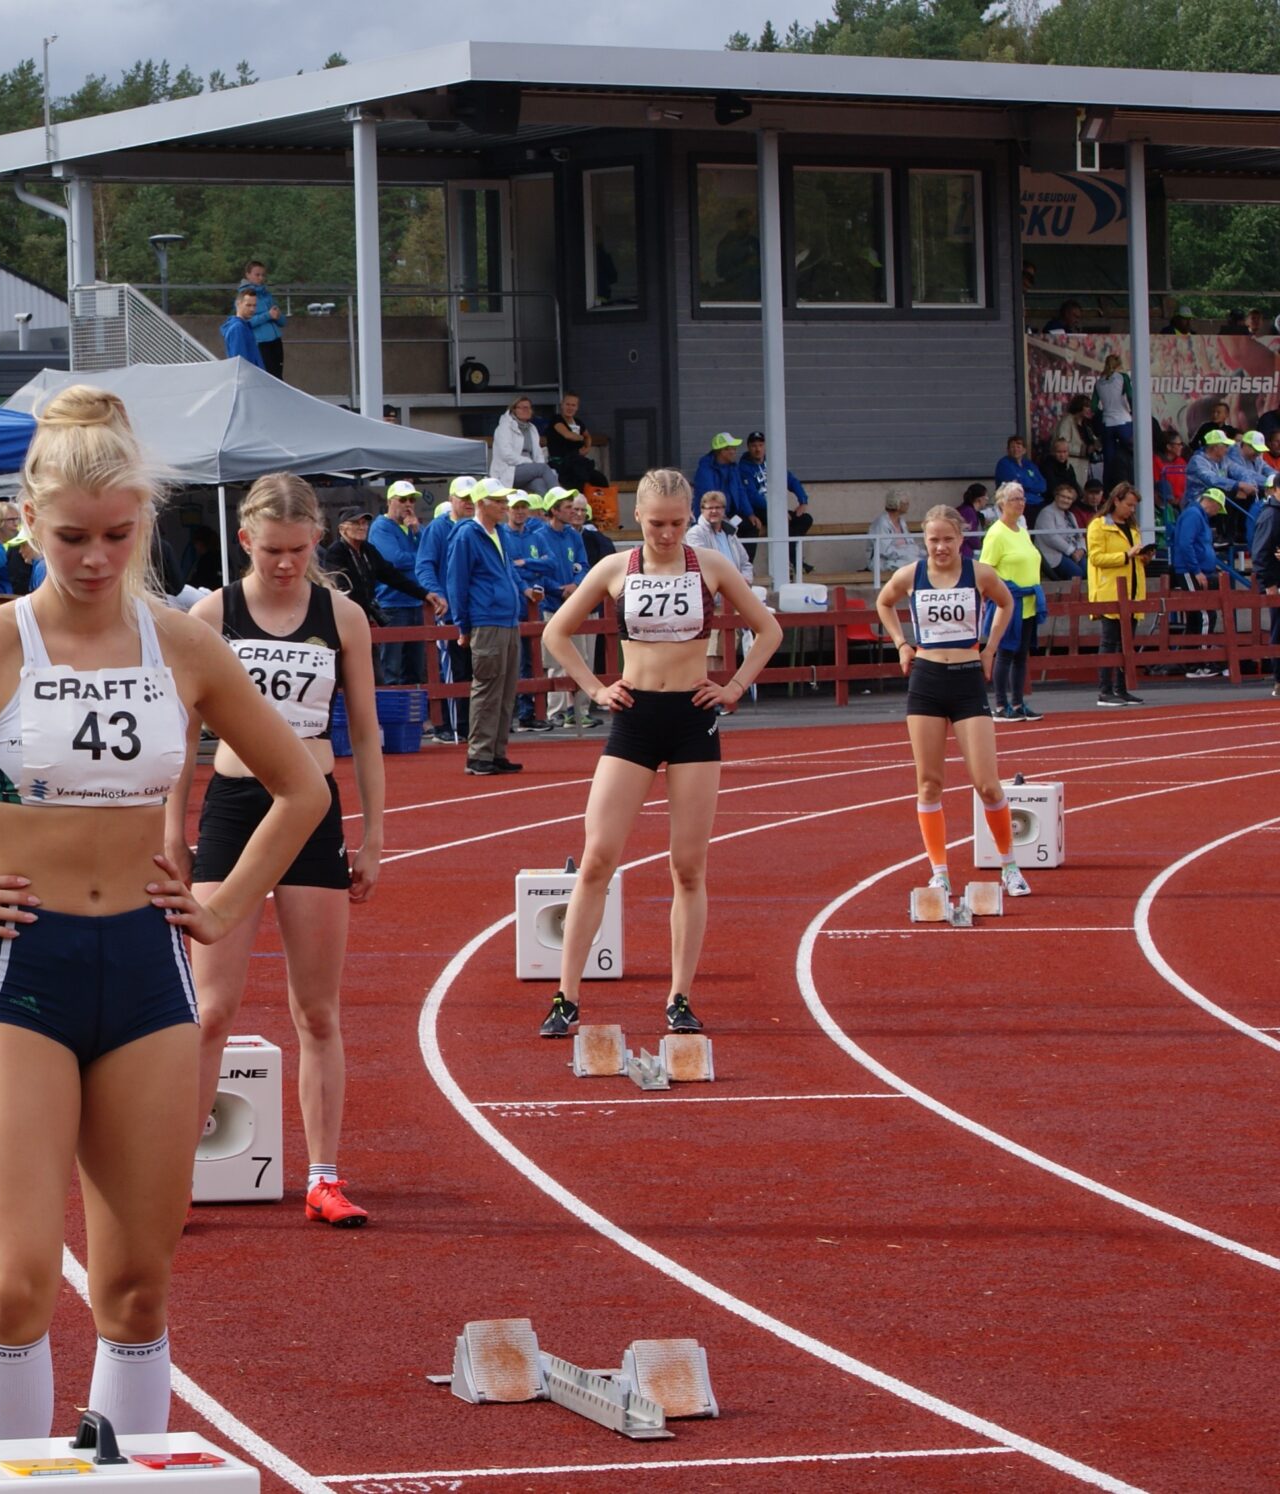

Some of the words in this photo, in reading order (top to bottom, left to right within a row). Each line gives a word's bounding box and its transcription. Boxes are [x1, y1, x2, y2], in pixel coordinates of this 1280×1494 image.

[638, 593, 689, 617] 275
[921, 593, 959, 602] CRAFT
[928, 605, 965, 622] 560
[238, 647, 310, 664] CRAFT
[34, 678, 137, 700] CRAFT
[248, 667, 317, 703] 367
[72, 711, 141, 761] 43
[1037, 844, 1048, 862] 5
[597, 948, 613, 971] 6
[251, 1157, 272, 1188] 7
